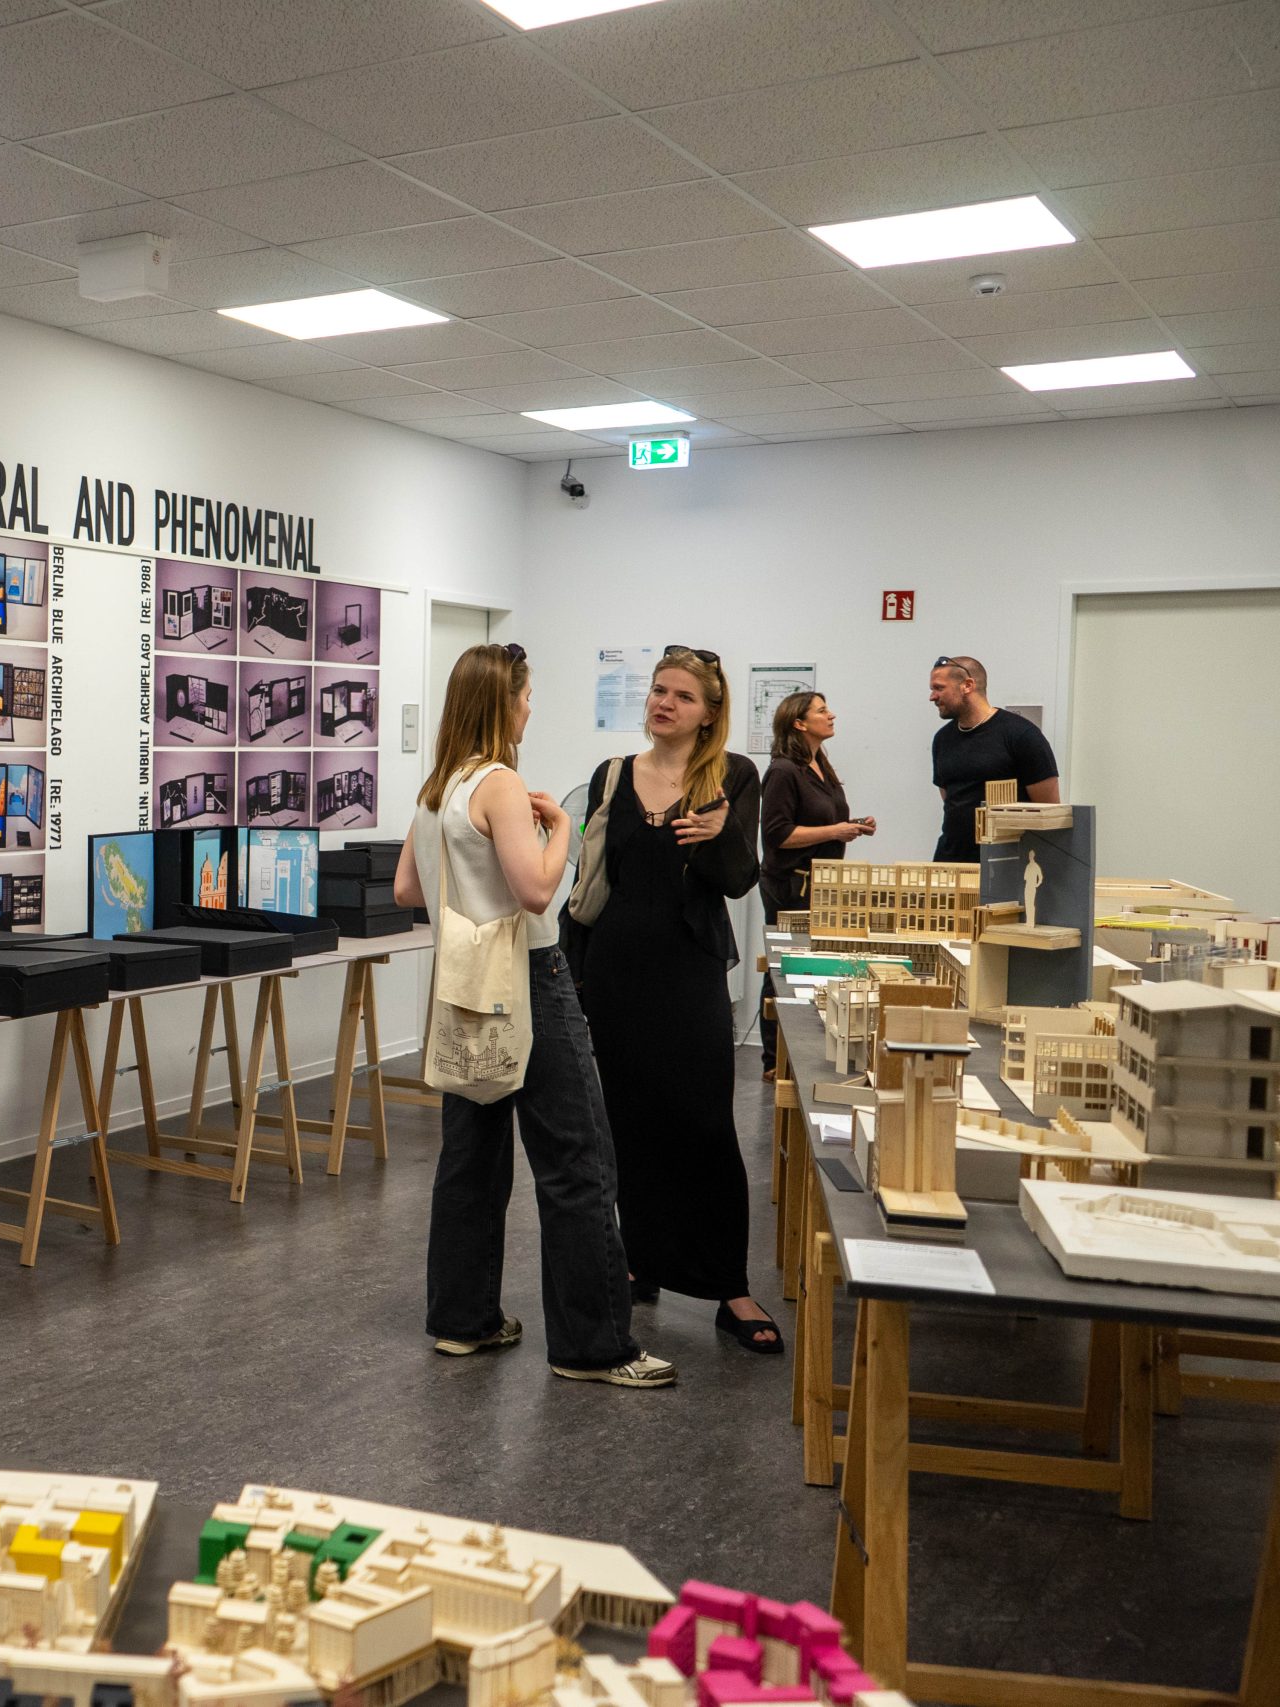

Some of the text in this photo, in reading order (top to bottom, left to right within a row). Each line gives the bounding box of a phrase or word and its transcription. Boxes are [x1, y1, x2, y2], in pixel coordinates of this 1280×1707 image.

[73, 475, 135, 547] AND
[155, 489, 321, 574] PHENOMENAL
[141, 559, 152, 594] 1988]
[50, 546, 64, 850] BERLIN: BLUE ARCHIPELAGO [RE: 1977]
[140, 634, 151, 725] ARCHIPELAGO
[139, 729, 150, 785] UNBUILT
[138, 791, 149, 832] ERLIN:
